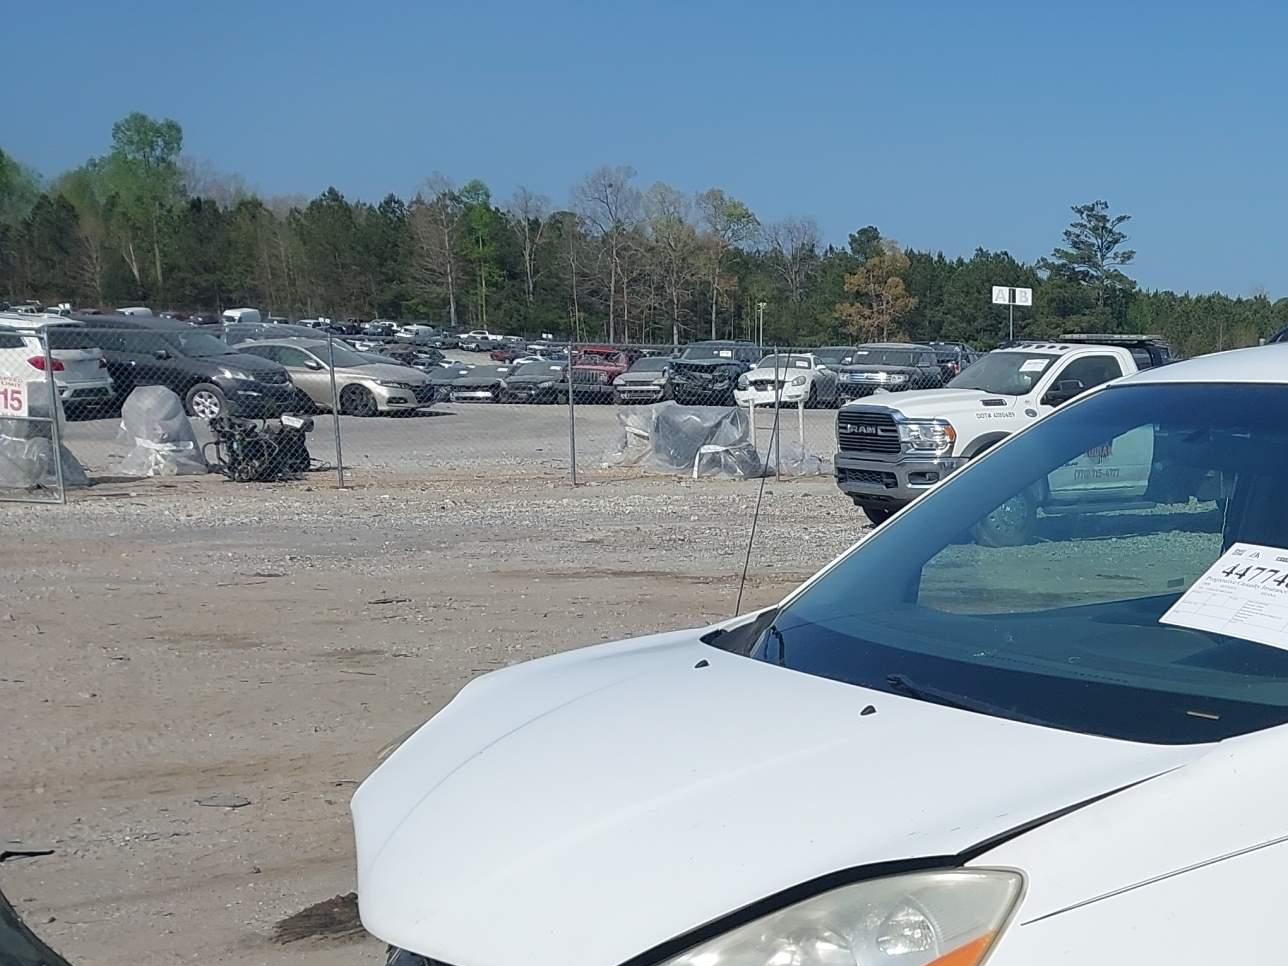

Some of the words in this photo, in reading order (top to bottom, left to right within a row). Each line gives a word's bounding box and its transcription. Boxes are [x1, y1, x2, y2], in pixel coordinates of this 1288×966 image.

[994, 288, 1007, 302] A
[1019, 290, 1029, 303] B
[0, 388, 22, 411] 15
[851, 425, 877, 434] RAM
